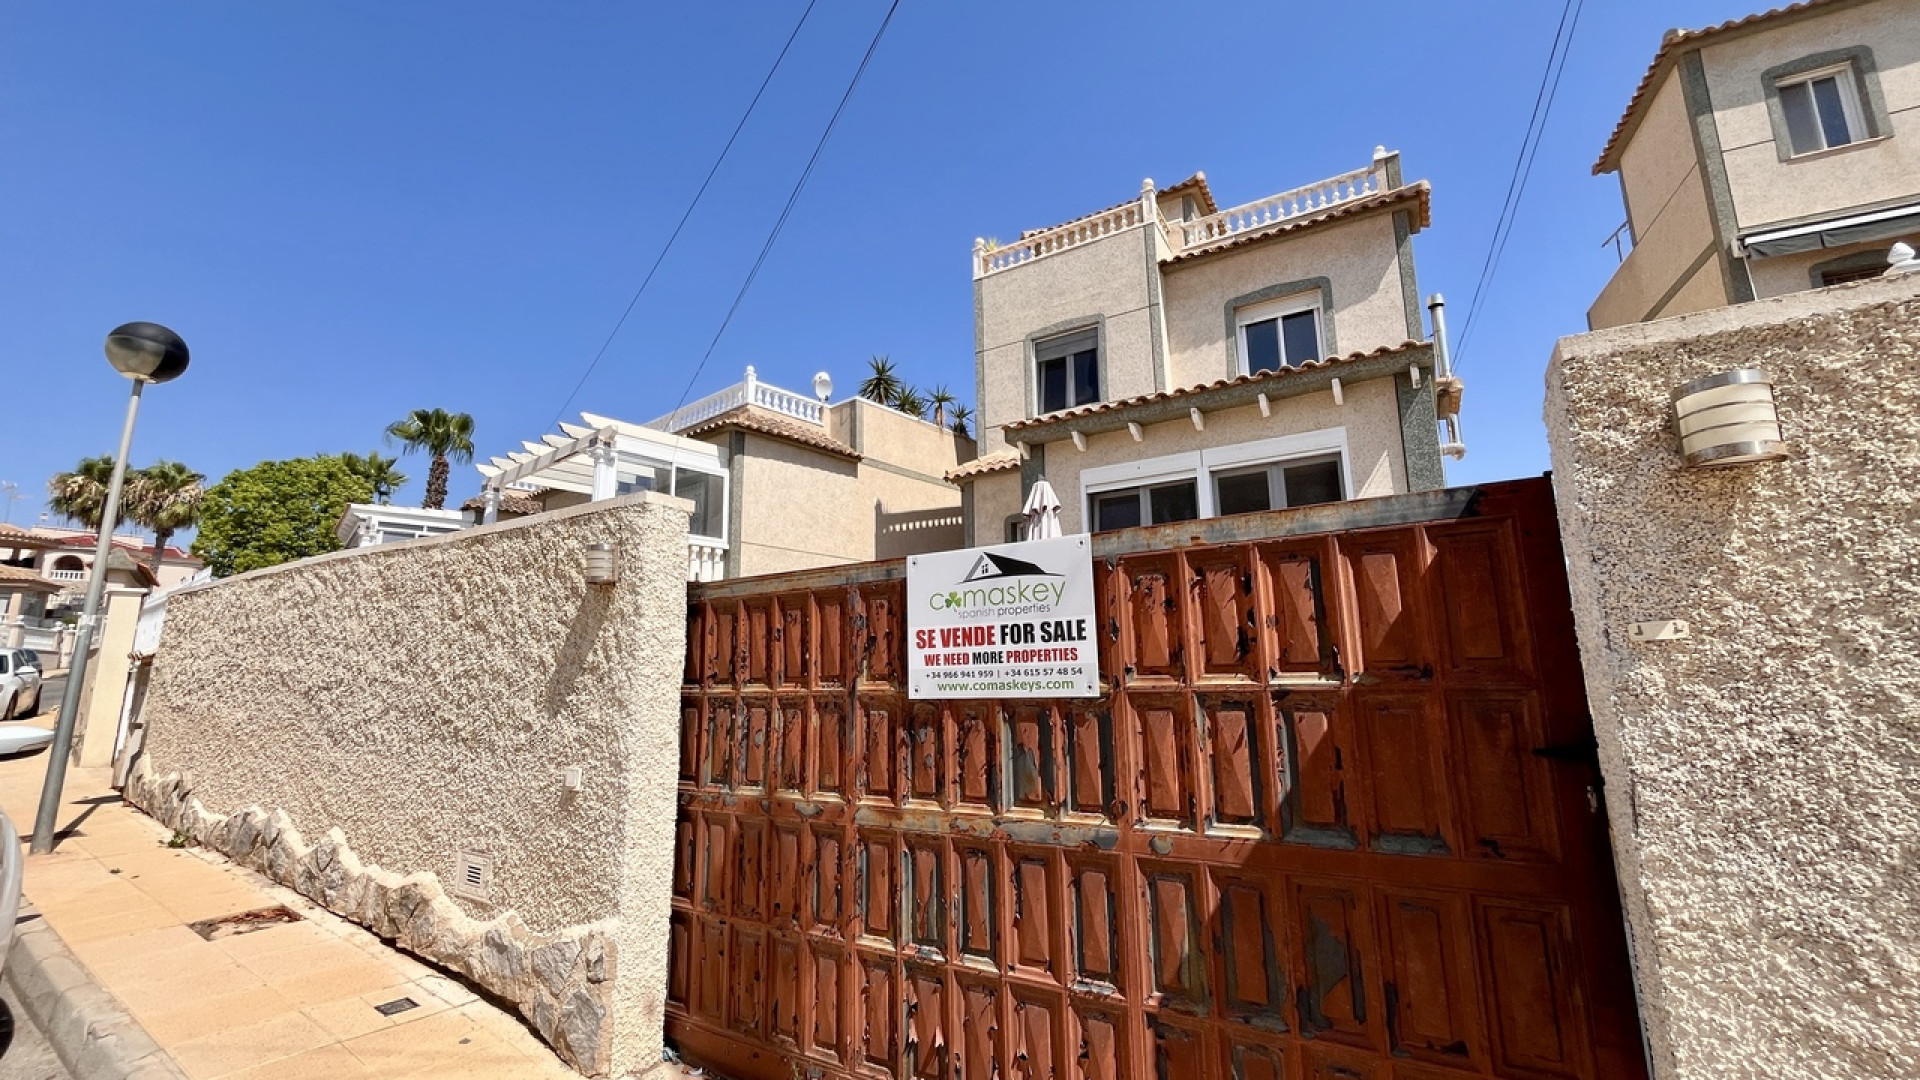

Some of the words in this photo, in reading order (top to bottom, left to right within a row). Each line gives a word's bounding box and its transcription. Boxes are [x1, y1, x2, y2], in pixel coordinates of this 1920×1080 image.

[958, 607, 995, 619] spanish
[997, 603, 1051, 618] properties
[916, 629, 937, 650] SE
[940, 625, 996, 649] VENDE
[1000, 622, 1036, 646] FOR
[1040, 619, 1087, 643] SALE
[924, 653, 941, 667] WE
[943, 652, 970, 667] NEED
[972, 650, 1004, 666] MORE
[1006, 647, 1078, 664] PROPERTIES
[925, 671, 942, 679] +34
[960, 670, 976, 679] 941
[977, 669, 994, 679] 959
[1004, 668, 1022, 678] +34
[1023, 668, 1041, 677] 615
[1042, 668, 1054, 677] 57
[1056, 667, 1069, 676] 48
[1070, 667, 1083, 676] 54
[937, 679, 1075, 693] www.comaskeys.com
